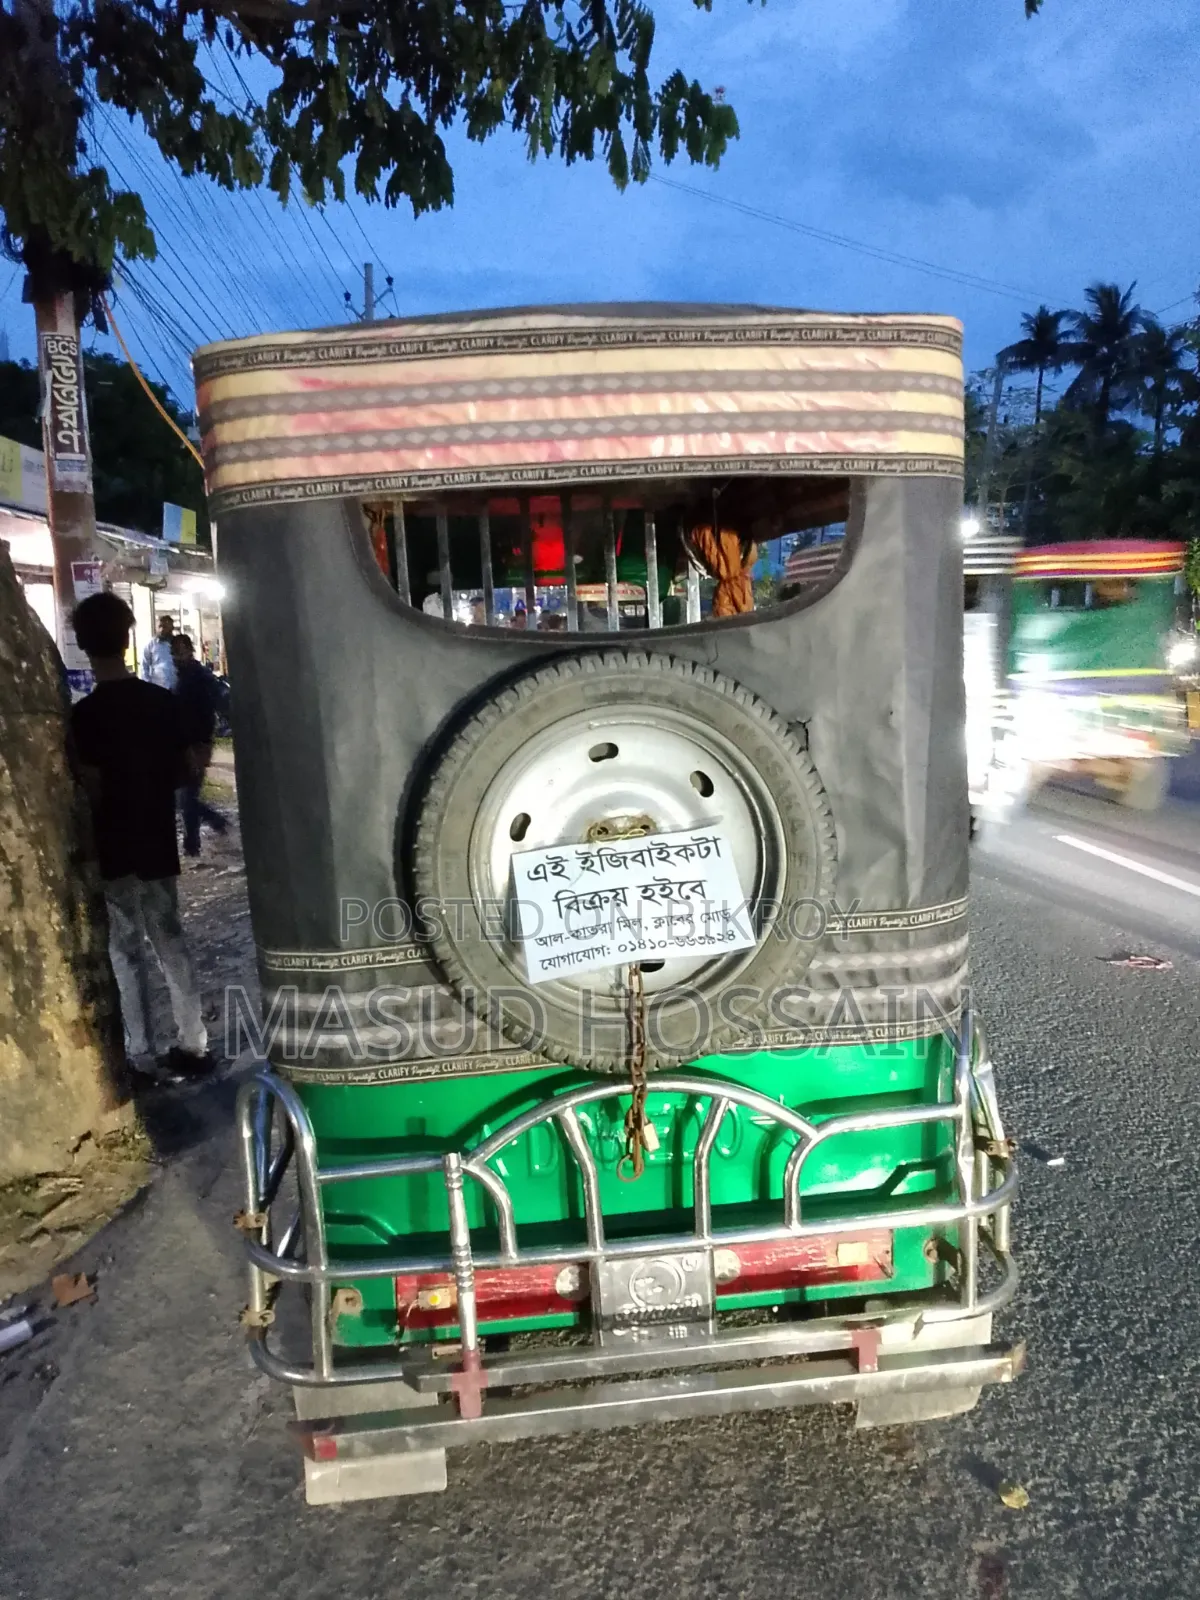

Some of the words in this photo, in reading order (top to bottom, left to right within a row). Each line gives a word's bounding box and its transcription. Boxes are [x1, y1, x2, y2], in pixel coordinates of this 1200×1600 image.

[47, 340, 77, 355] BCS
[248, 351, 280, 365] CLARIFY
[318, 348, 353, 360] CLARIFY
[390, 342, 424, 355] CLARIFY
[460, 338, 494, 350] CLARIFY
[530, 334, 565, 346] CLARIFY
[600, 332, 634, 344] CLARIFY
[668, 330, 702, 341] CLARIFY
[735, 329, 769, 341] CLARIFY
[801, 329, 835, 341] CLARIFY
[867, 329, 900, 341] CLARIFY
[305, 483, 340, 496] CLARIFY
[374, 476, 409, 489] CLARIFY
[443, 472, 478, 485] CLARIFY
[512, 468, 546, 480] CLARIFY
[580, 465, 613, 476] CLARIFY
[647, 463, 680, 473] CLARIFY
[714, 460, 747, 470] CLARIFY
[779, 459, 811, 469] CLARIFY
[843, 459, 875, 470] CLARIFY
[906, 460, 933, 471] CLARIFY
[527, 854, 570, 883] এই
[575, 836, 721, 875] ইজিবাইকটা
[552, 887, 629, 919] বিক্রয়
[636, 876, 707, 907] হইবে
[847, 917, 878, 928] CLARIFY
[909, 912, 936, 925] CLARIFY
[283, 956, 310, 968] CLARIFY
[341, 954, 373, 966] CLARIFY
[406, 948, 428, 959] CLAR
[539, 944, 611, 971] যোগাযোগ:
[875, 1027, 905, 1038] CLARIFY
[377, 1067, 410, 1079] CLARIFY
[442, 1061, 474, 1071] CLARIFY
[505, 1054, 537, 1066] CLARIFY
